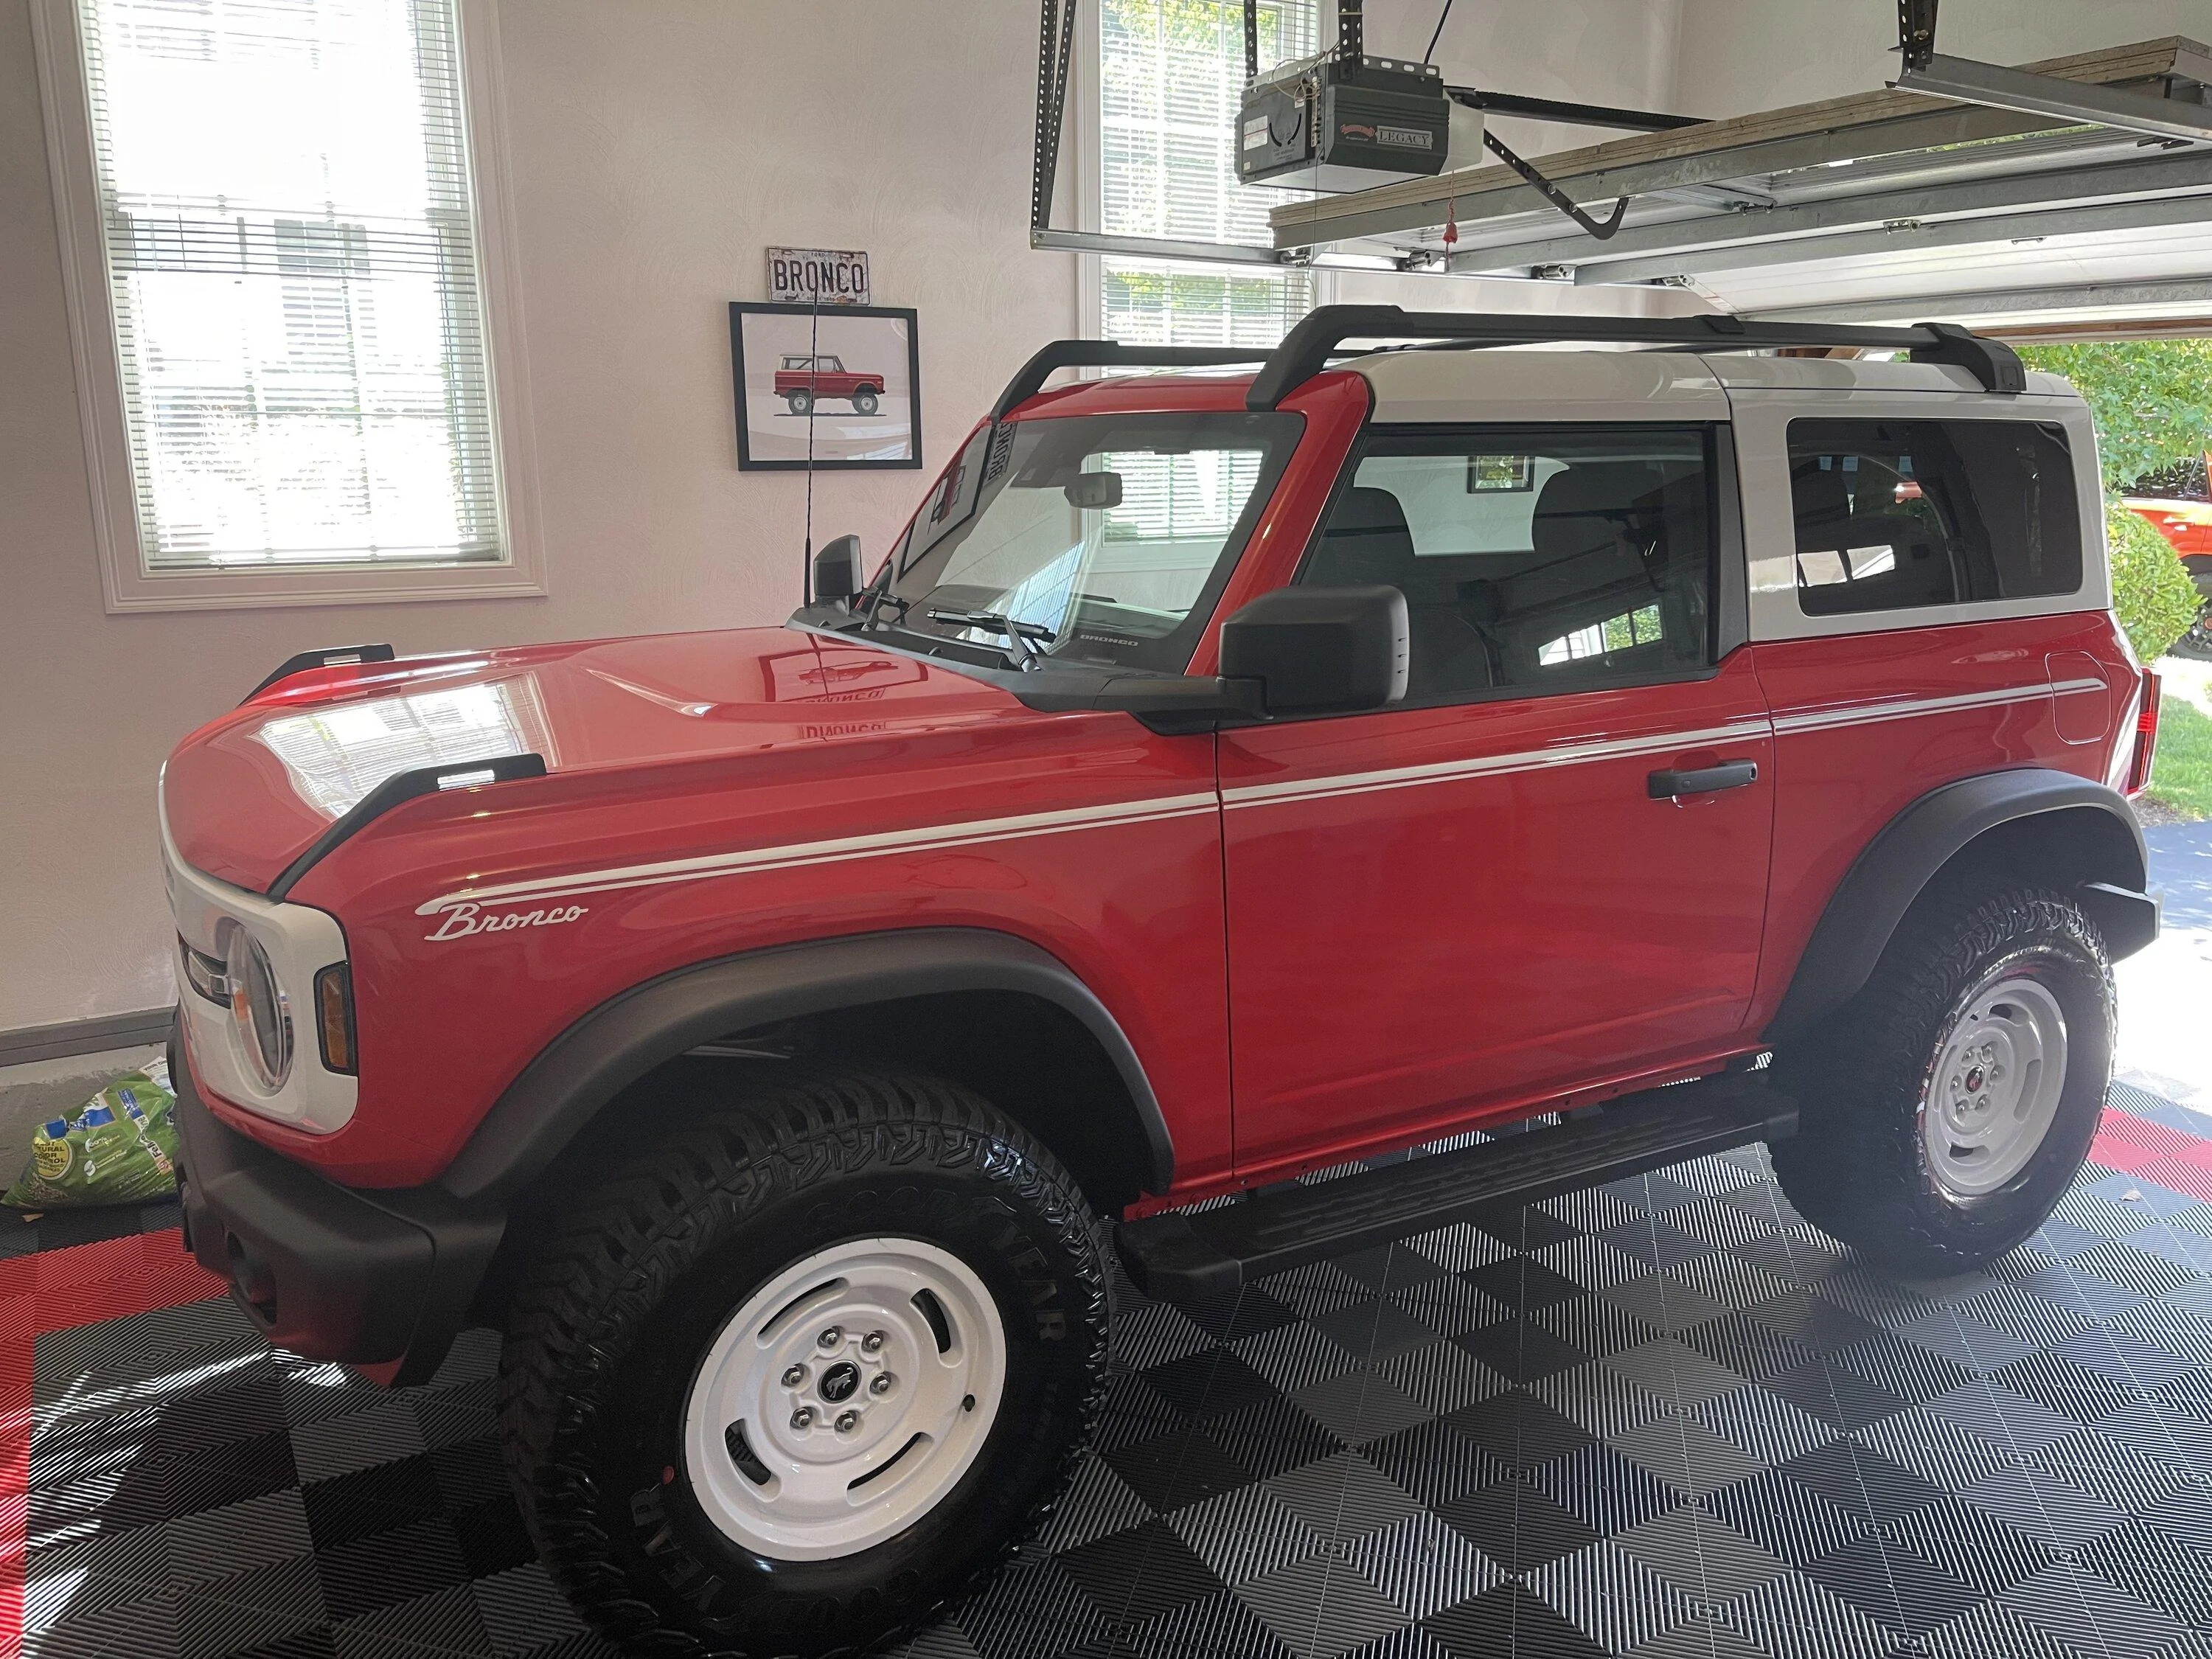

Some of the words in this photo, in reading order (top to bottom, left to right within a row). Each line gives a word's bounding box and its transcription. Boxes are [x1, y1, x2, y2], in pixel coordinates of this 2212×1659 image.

[1379, 131, 1429, 145] LEGACY
[773, 260, 864, 293] BRONCO
[1079, 634, 1138, 647] BRONCO
[424, 903, 589, 941] Bronco
